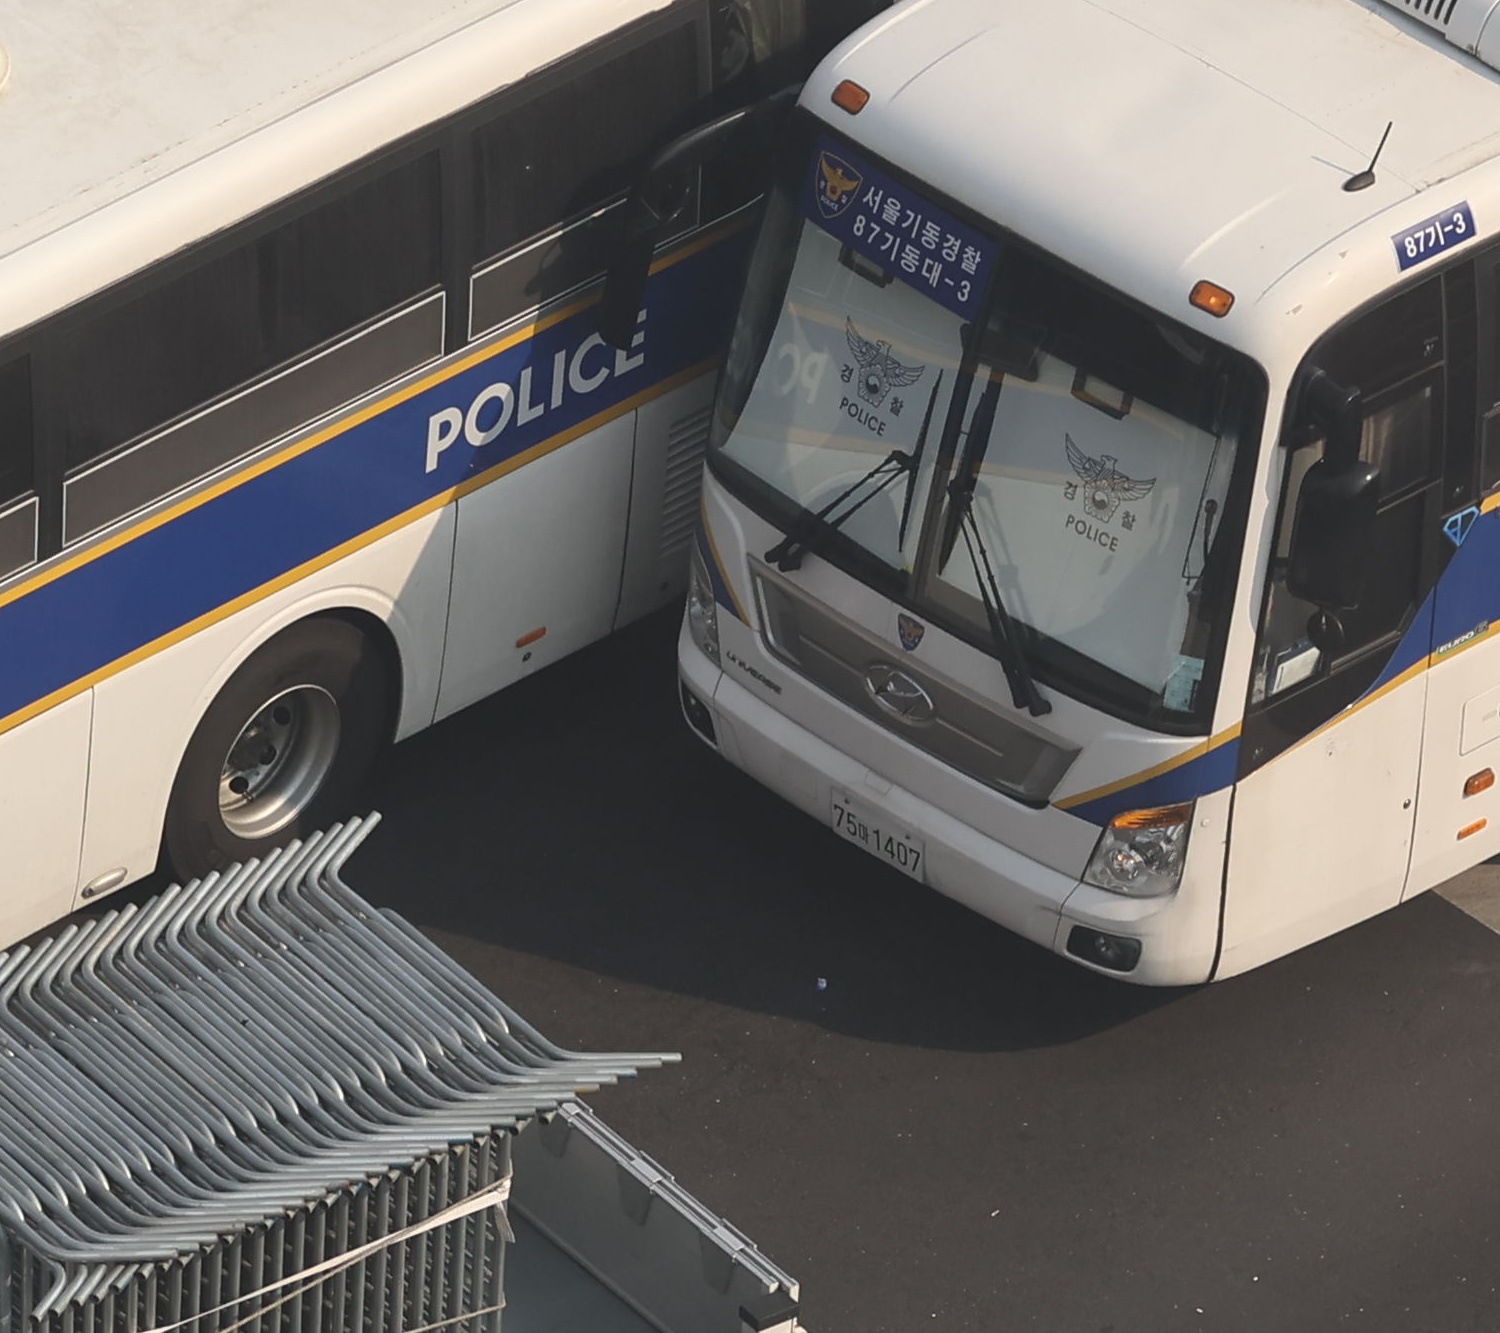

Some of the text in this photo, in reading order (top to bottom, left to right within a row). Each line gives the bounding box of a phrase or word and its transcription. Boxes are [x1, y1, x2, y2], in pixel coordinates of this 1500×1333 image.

[852, 214, 972, 304] 87기동대-3
[862, 185, 982, 276] 서울기동경찰
[1403, 212, 1467, 259] 87기-3
[426, 309, 648, 475] POLICE
[838, 396, 888, 438] POLICE
[1065, 514, 1120, 553] POLICE
[832, 803, 921, 873] 75마1407
